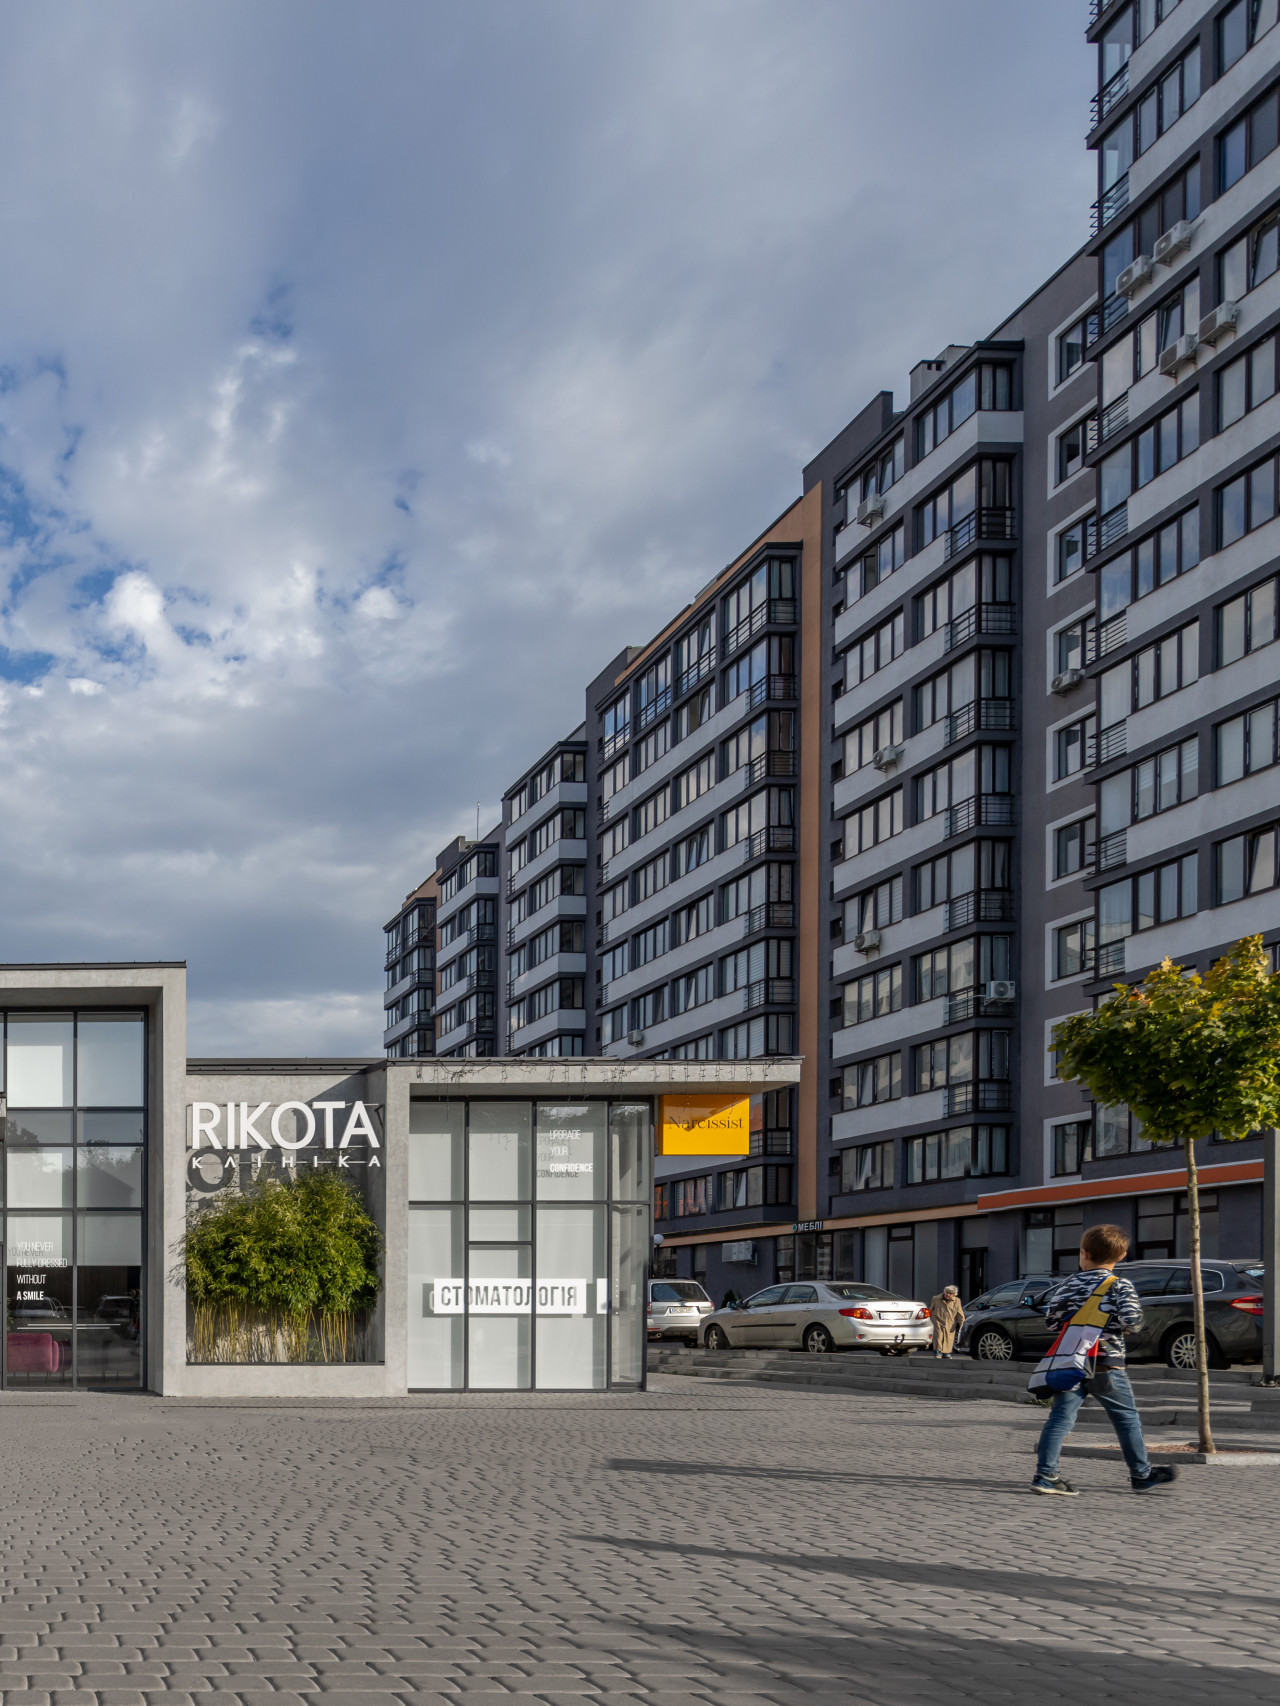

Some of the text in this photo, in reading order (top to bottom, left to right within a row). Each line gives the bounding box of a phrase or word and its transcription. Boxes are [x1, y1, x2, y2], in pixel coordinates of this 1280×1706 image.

[192, 1100, 381, 1150] RIKOTA
[668, 1115, 745, 1130] Narcissist
[549, 1129, 581, 1140] UPGRADE
[550, 1146, 569, 1157] YOUR
[192, 1155, 381, 1169] КЛІНІКА
[549, 1163, 593, 1173] CONFIDENCE
[16, 1241, 54, 1252] YOU NEVER
[16, 1258, 68, 1268] FULLY DRESSED
[16, 1274, 47, 1284] WITHOUT
[16, 1290, 45, 1300] A SMILE
